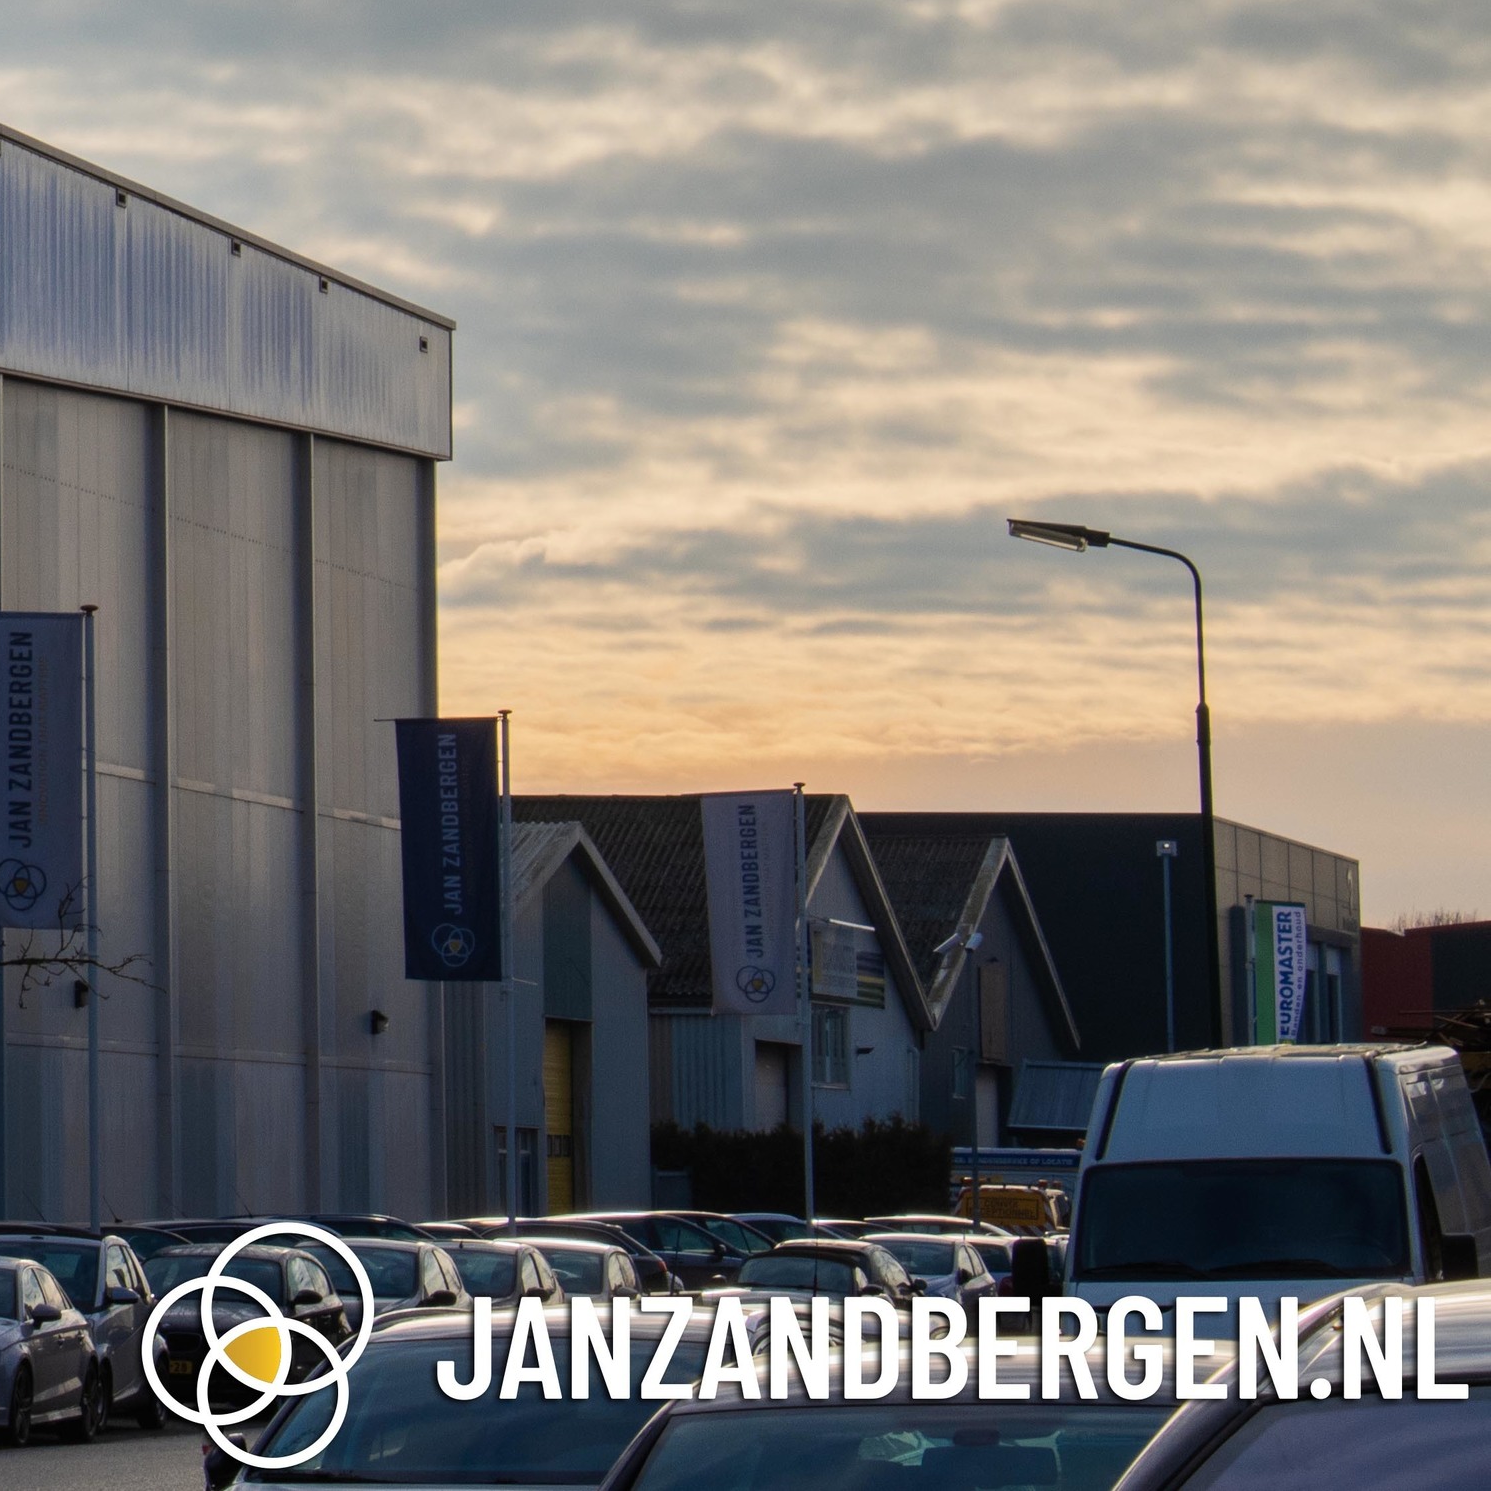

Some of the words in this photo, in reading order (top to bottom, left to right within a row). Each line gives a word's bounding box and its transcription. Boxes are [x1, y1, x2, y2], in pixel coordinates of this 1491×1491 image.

[8, 631, 33, 792] ZANDBERGEN
[8, 800, 32, 849] JAN
[437, 733, 461, 868] ZANDBERGEN
[443, 875, 463, 915] JAN
[737, 804, 762, 918] ZANDBERGEN
[745, 924, 764, 959] JAN
[1276, 911, 1294, 1036] EUROMASTER
[1294, 911, 1304, 972] onderhoud
